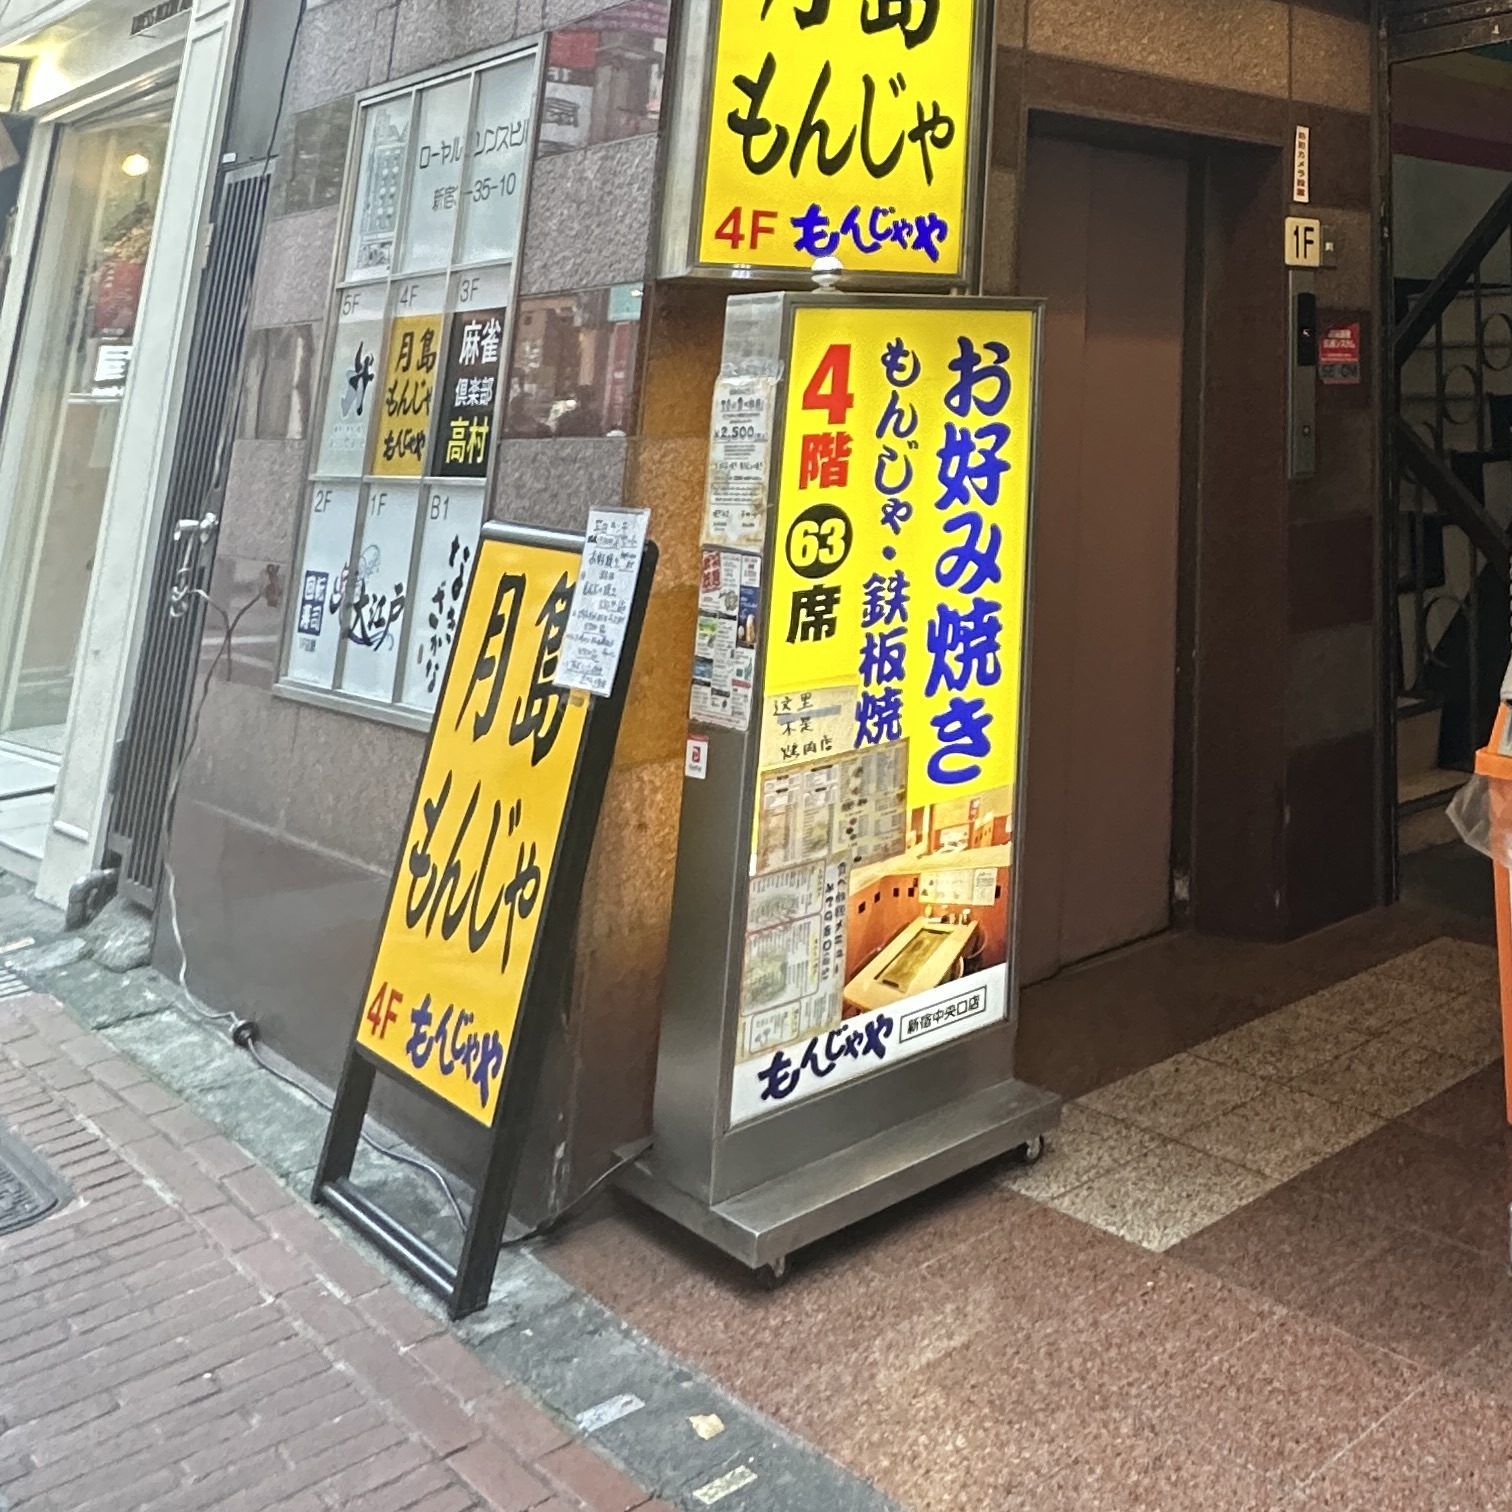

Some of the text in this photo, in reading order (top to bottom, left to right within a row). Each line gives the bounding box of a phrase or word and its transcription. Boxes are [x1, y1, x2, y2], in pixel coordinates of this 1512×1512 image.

[727, 51, 956, 186] もんじゃ
[715, 203, 949, 262] 4F もんじゃや
[1293, 225, 1315, 259] 1F
[342, 293, 362, 316] 5F
[400, 285, 420, 307] 4F
[460, 278, 480, 304] 3F
[396, 326, 437, 373] 月島
[459, 319, 499, 365] 麻雀
[454, 376, 493, 408] 倶楽部
[446, 415, 489, 464] 高村
[314, 490, 333, 513] 2F
[369, 492, 388, 517] 1F
[430, 494, 450, 521] B1
[785, 343, 854, 644] 4階 63 席
[854, 337, 921, 749] もんじゃ・鉄板焼
[923, 335, 1011, 786] お好み焼き
[351, 577, 405, 652] 大江戸
[454, 570, 577, 768] 月島
[404, 769, 541, 974] もんじゃ
[366, 980, 504, 1108] 4F もんじゃや
[758, 1013, 893, 1102] もんじゃや
